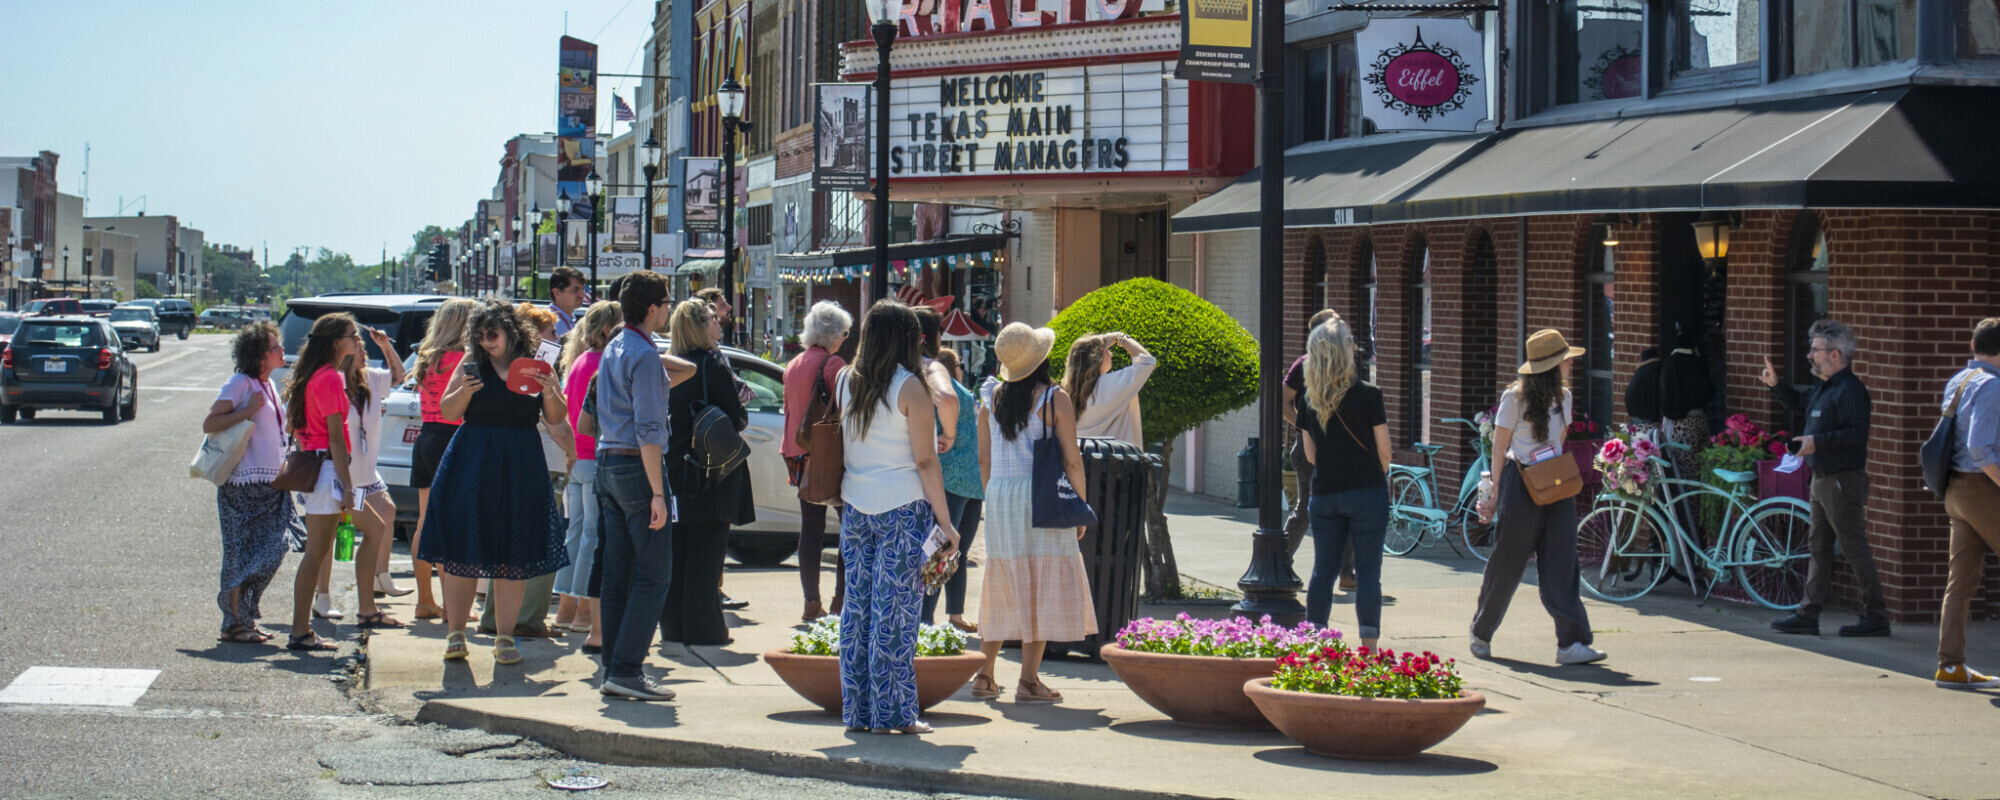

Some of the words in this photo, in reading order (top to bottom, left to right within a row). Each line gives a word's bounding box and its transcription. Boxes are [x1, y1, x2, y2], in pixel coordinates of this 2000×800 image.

[940, 72, 1045, 108] WELCOME
[1398, 68, 1444, 91] Eiffel
[907, 109, 988, 143] TEXAS
[1006, 105, 1072, 137] MAIN
[890, 143, 979, 174] STREET
[993, 137, 1128, 171] MANAGERS
[624, 257, 640, 268] on
[913, 254, 990, 269] SUGAR
